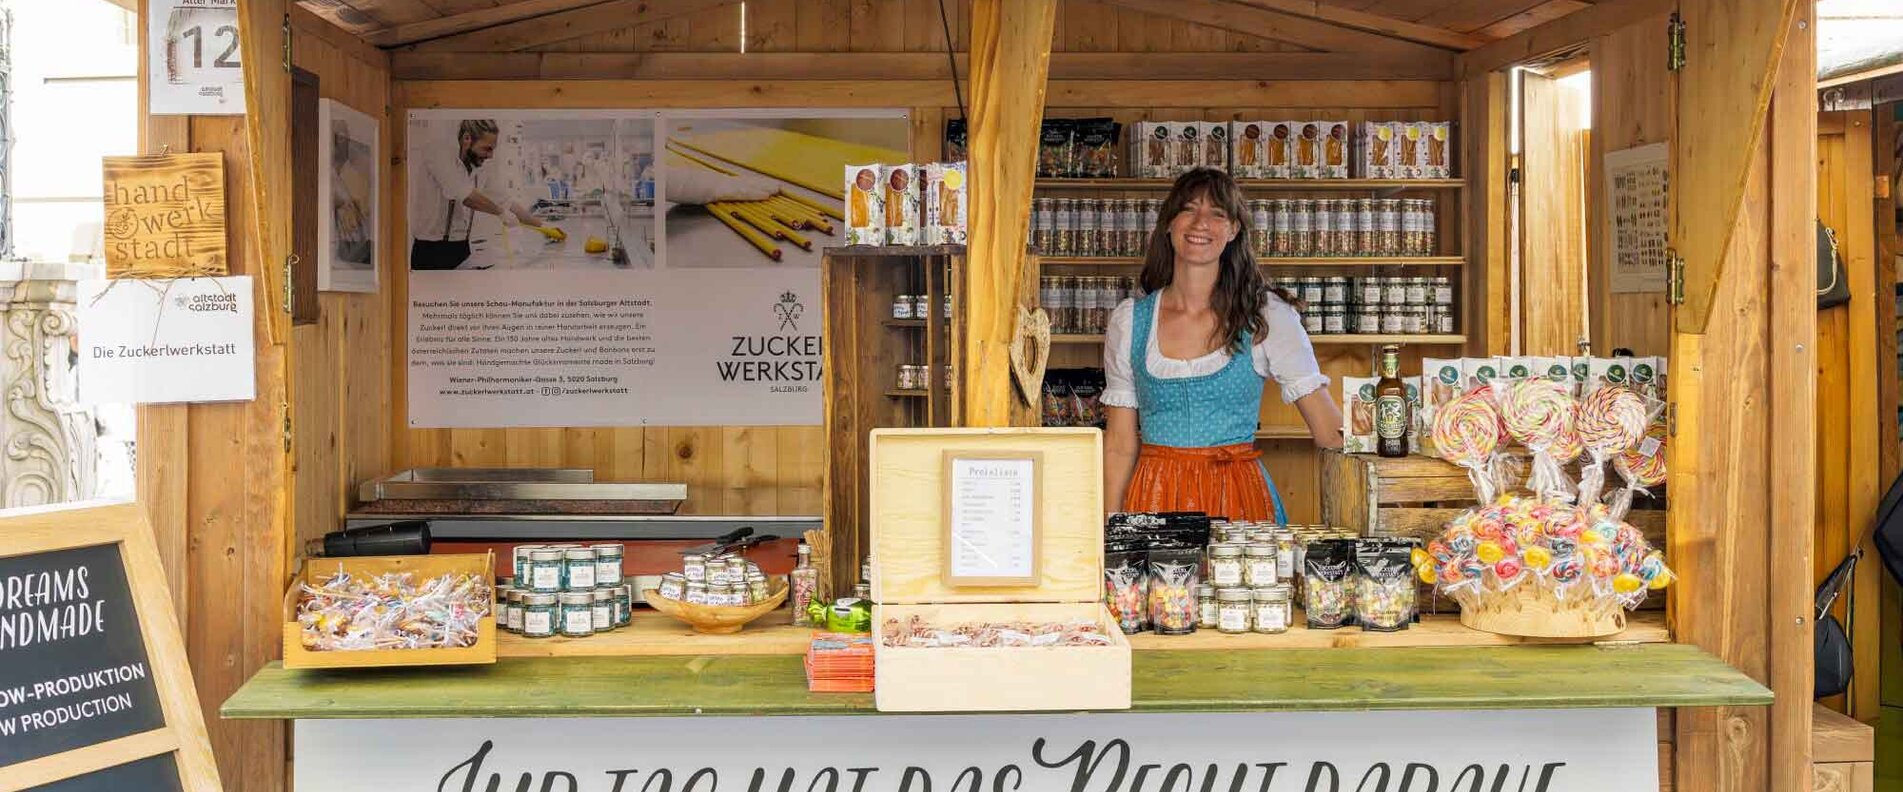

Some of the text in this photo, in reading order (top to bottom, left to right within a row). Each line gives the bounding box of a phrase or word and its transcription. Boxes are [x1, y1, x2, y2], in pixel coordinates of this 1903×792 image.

[183, 25, 241, 68] 12
[114, 175, 191, 205] hand
[141, 196, 214, 235] werk
[116, 232, 194, 261] stadt
[188, 302, 238, 313] salzburg
[192, 292, 237, 303] altstadt
[93, 343, 236, 359] Die Zuckerlwerkstatt
[731, 336, 823, 356] ZUCKE
[0, 566, 89, 610] REAMS
[20, 692, 133, 733] PRODUCTION
